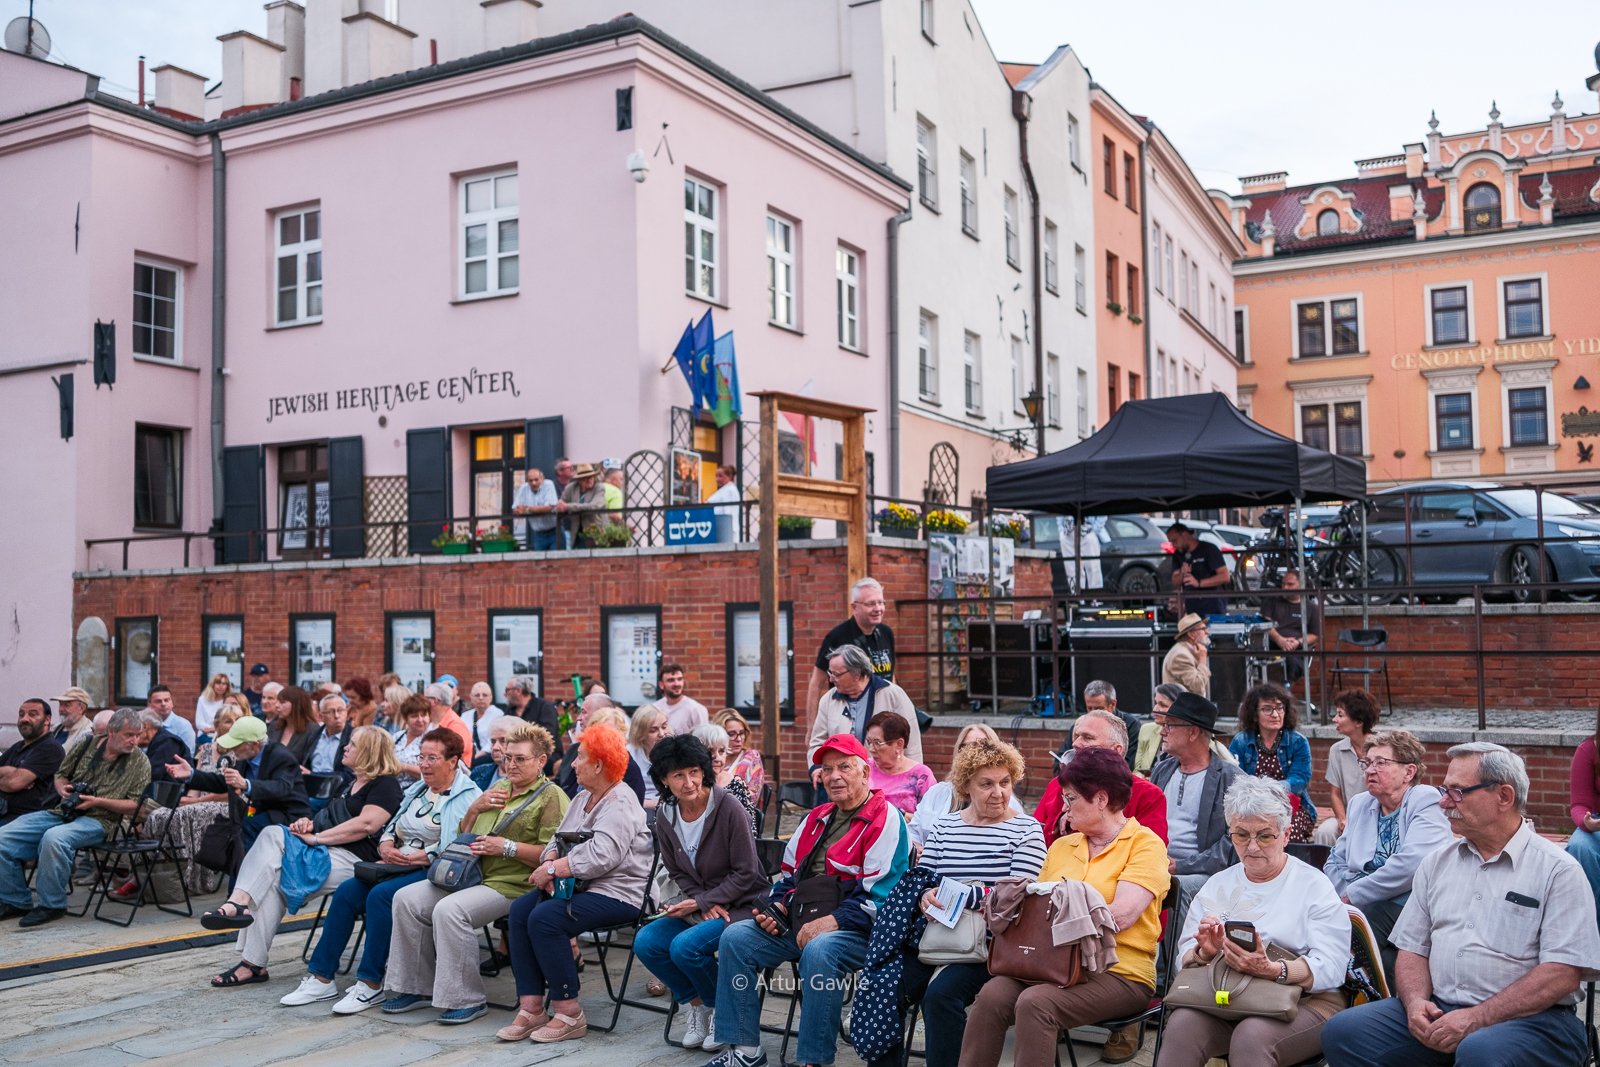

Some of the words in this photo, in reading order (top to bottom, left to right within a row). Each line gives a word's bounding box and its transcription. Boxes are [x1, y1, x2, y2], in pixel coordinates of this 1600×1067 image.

[1391, 342, 1555, 370] CENOTAPHIUM
[266, 391, 329, 424] JEWISH
[336, 380, 431, 413] HERITAGE
[436, 366, 521, 404] CENTER
[668, 510, 713, 541] שלום
